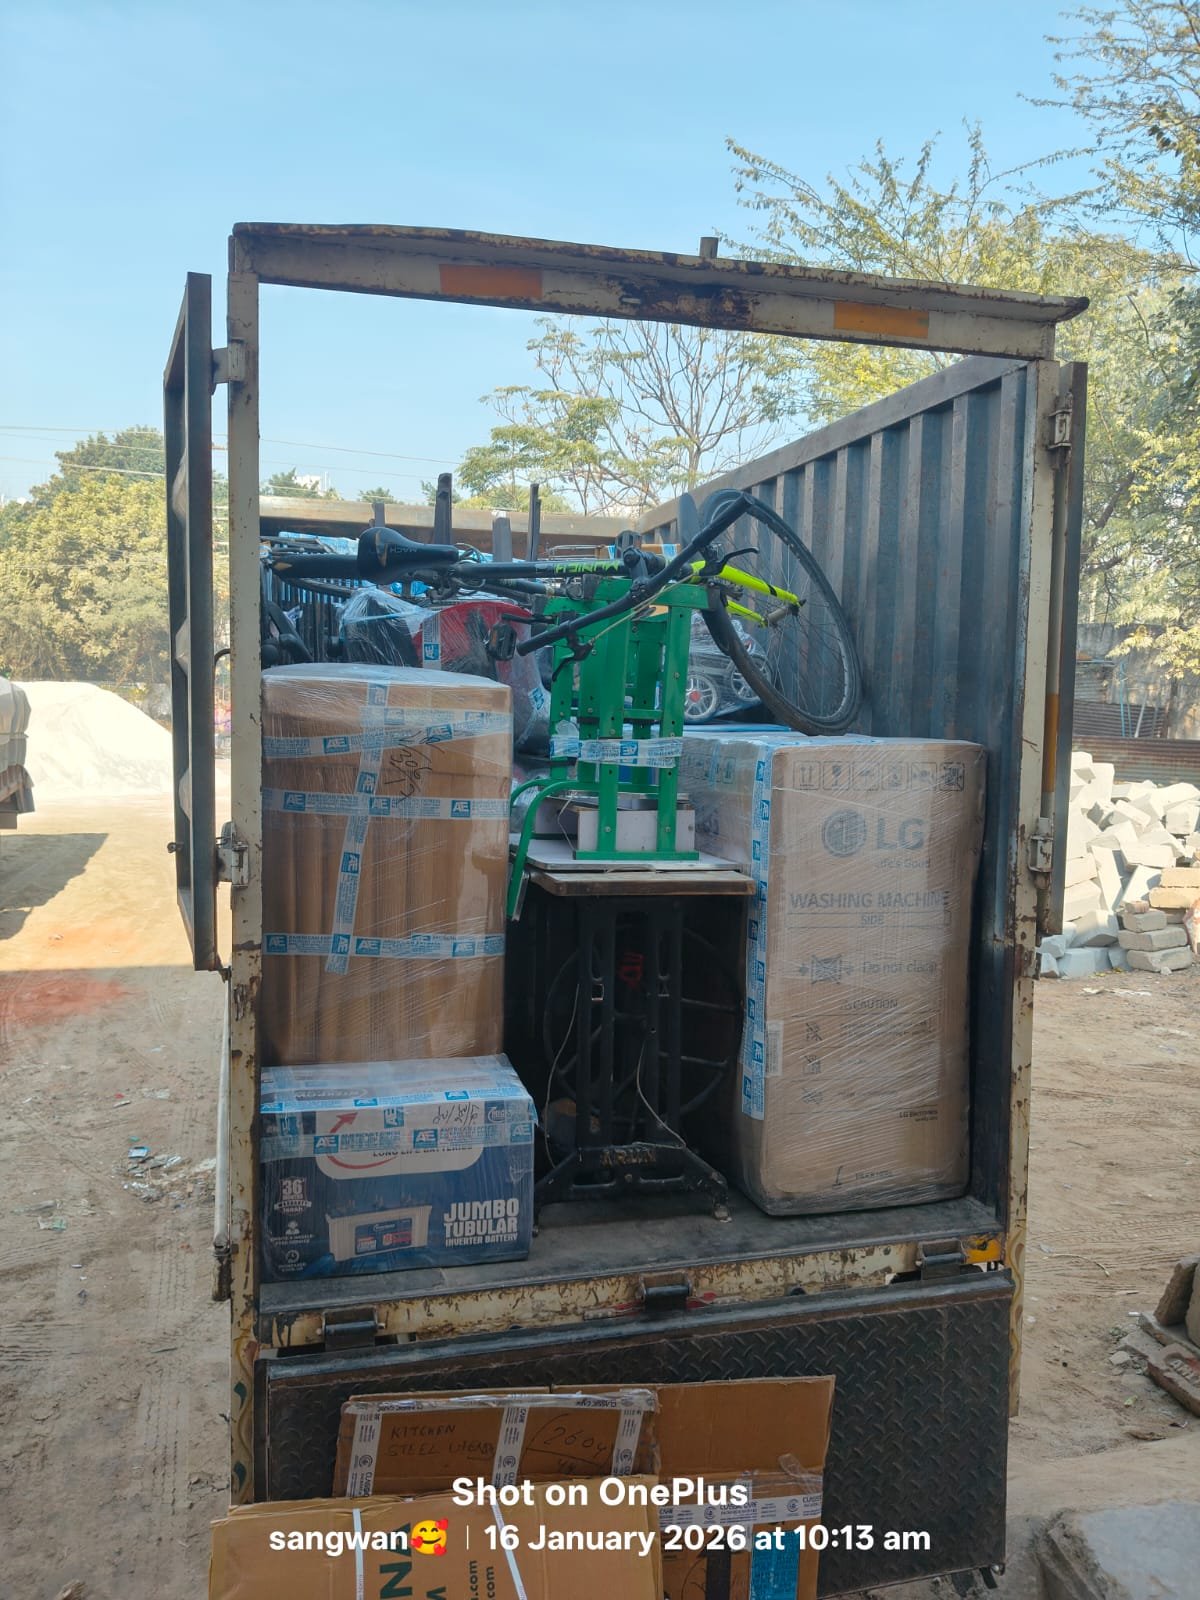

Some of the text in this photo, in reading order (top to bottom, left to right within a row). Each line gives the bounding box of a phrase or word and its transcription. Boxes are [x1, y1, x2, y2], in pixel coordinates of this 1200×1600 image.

[877, 817, 926, 850] LG
[790, 892, 873, 909] WASHING
[860, 914, 885, 926] SIDE
[282, 1179, 304, 1194] 36
[443, 1197, 520, 1222] JUMBO
[443, 1216, 518, 1239] TUBULAR
[445, 1232, 519, 1249] INVERTER BATTERY
[391, 1424, 457, 1440] KITCHEN
